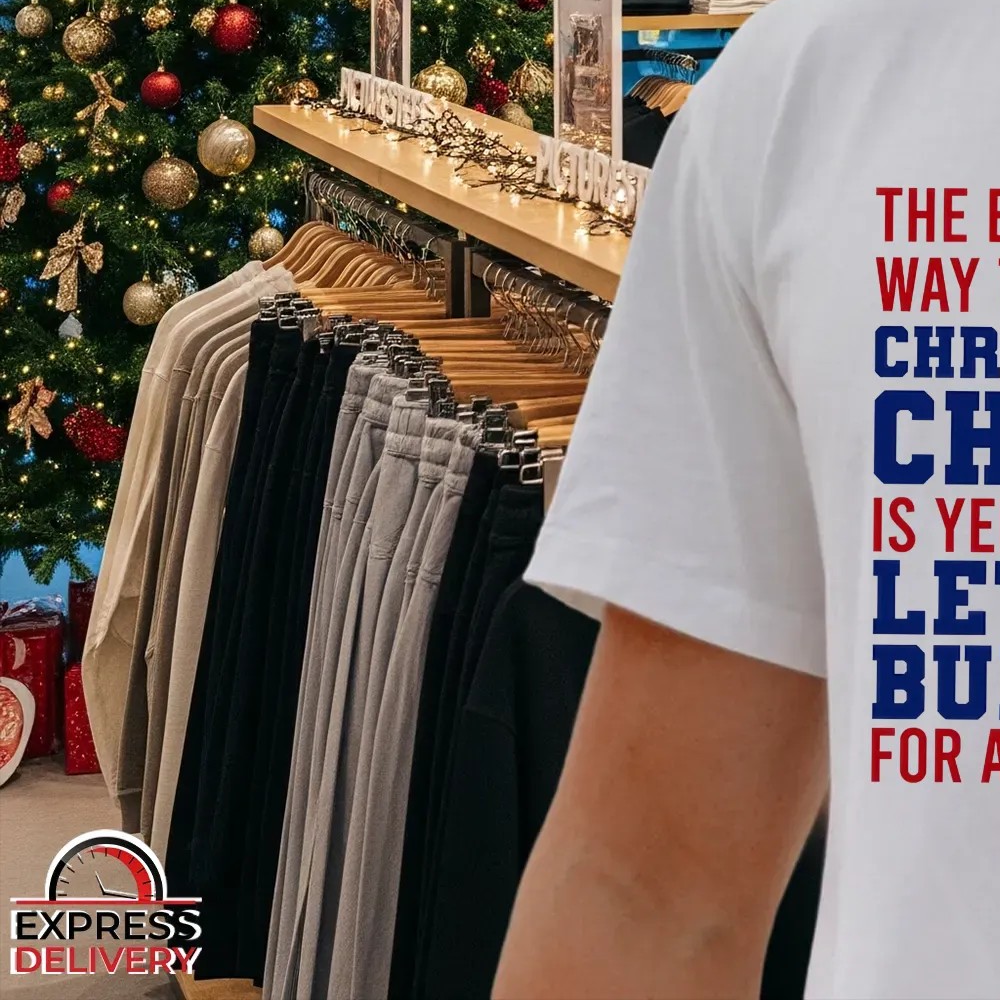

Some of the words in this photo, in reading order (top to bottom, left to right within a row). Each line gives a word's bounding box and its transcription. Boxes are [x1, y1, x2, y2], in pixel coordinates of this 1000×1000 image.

[876, 187, 968, 243] THE
[876, 256, 980, 313] WAY
[873, 497, 916, 553] IS
[871, 727, 961, 784] FOR
